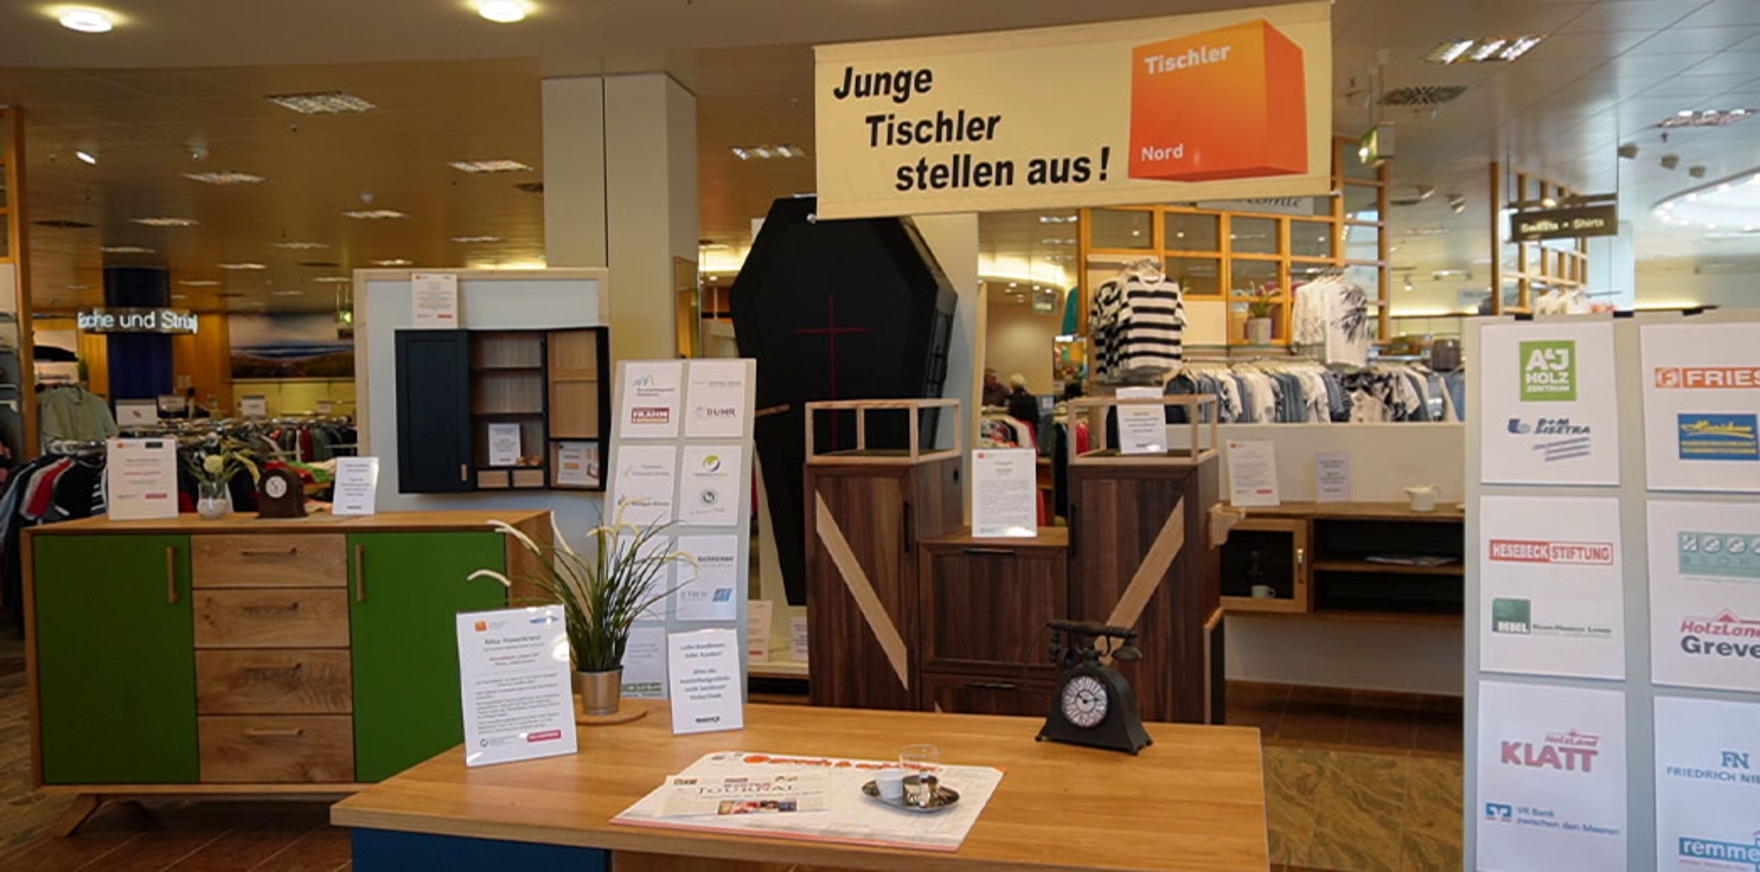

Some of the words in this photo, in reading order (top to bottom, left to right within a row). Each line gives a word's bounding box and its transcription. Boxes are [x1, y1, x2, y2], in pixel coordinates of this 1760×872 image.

[1144, 45, 1231, 75] Tischler
[833, 66, 933, 103] Junge
[865, 109, 1001, 148] Tischler
[1141, 144, 1184, 163] Nord
[895, 153, 1014, 191] stellen
[120, 311, 156, 328] und
[1525, 371, 1569, 385] HOLZ
[1492, 542, 1547, 558] HESEBECK
[1551, 546, 1610, 560] STIFTUNG
[1681, 620, 1760, 637] HolzLan
[1501, 740, 1598, 772] KLATT
[1721, 750, 1750, 770] FN
[1666, 766, 1736, 782] FRIEDRICH
